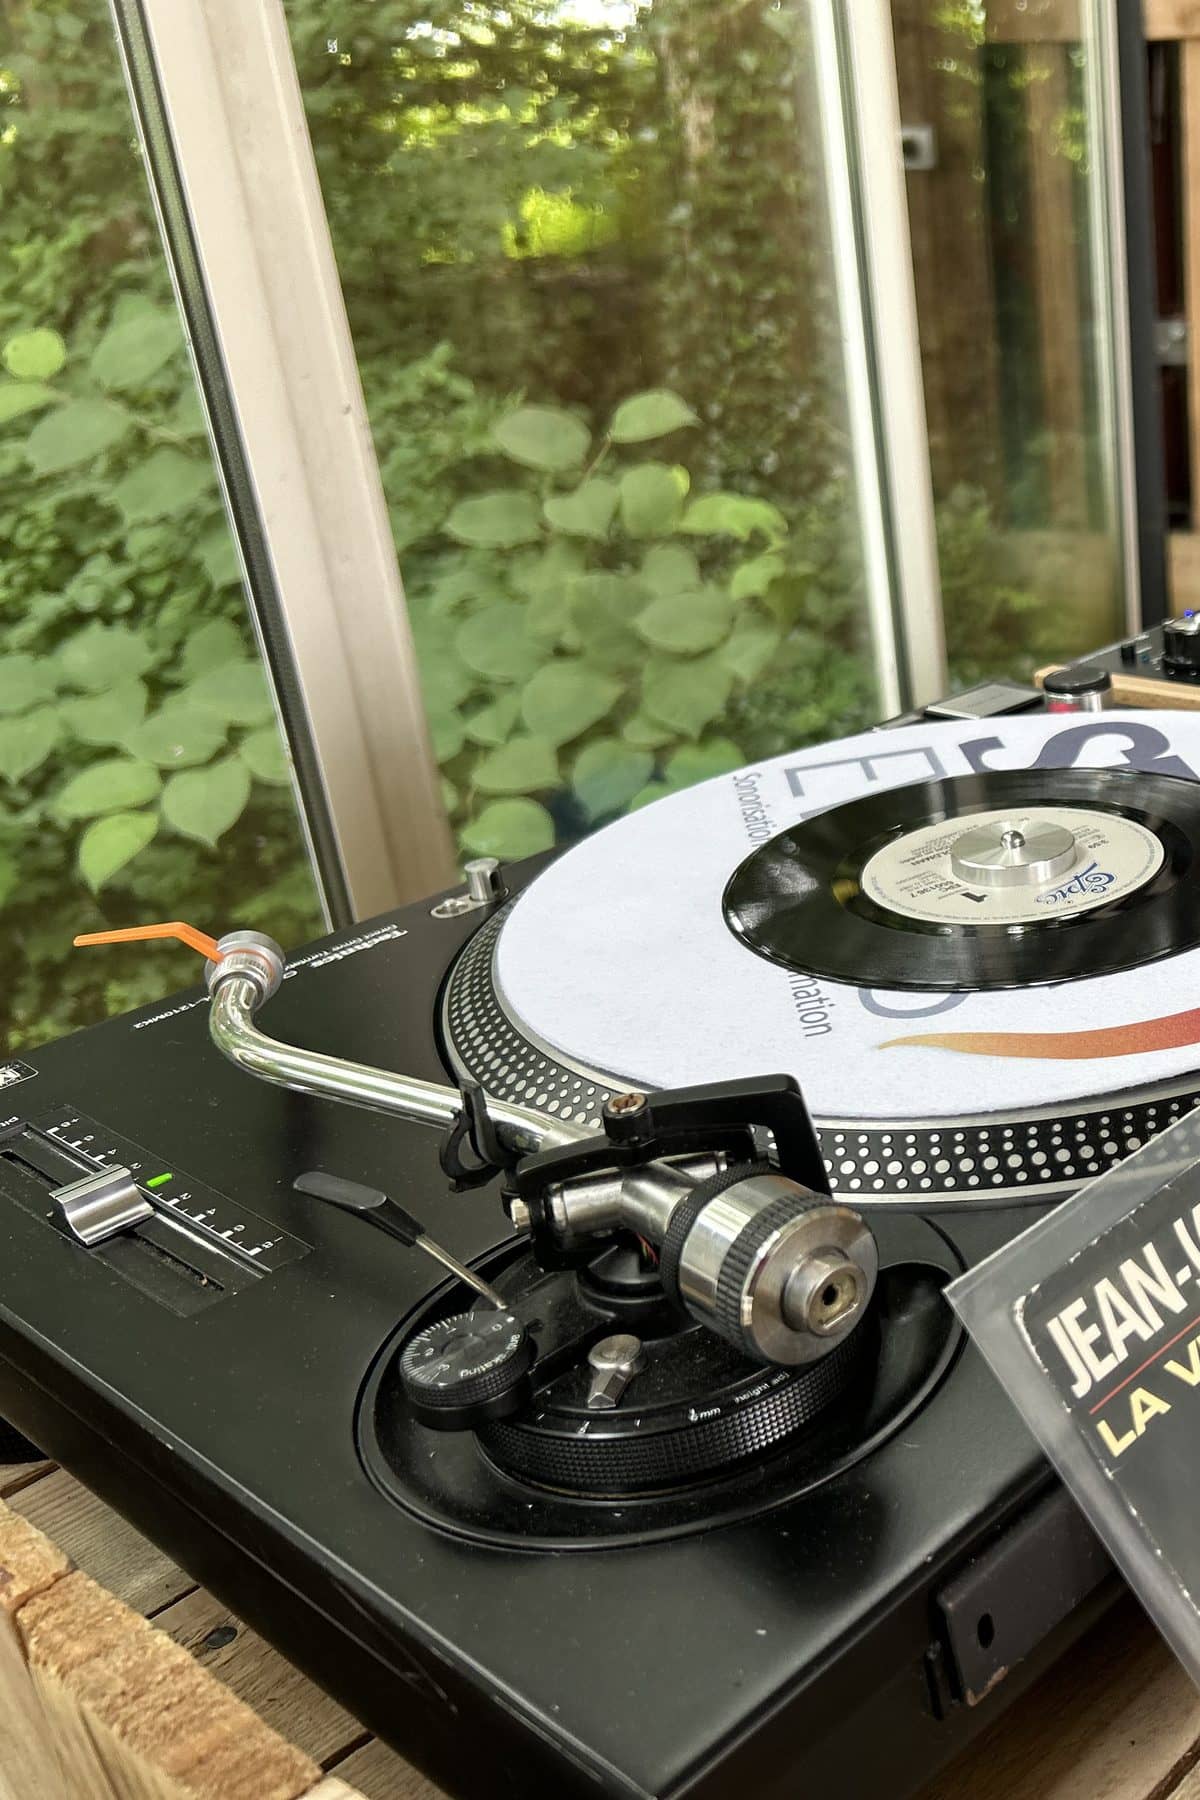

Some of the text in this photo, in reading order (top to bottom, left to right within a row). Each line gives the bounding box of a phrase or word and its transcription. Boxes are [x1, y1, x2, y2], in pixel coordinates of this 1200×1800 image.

[1036, 861, 1115, 904] Epic
[309, 929, 409, 968] Technics
[1096, 1387, 1172, 1457] LA
